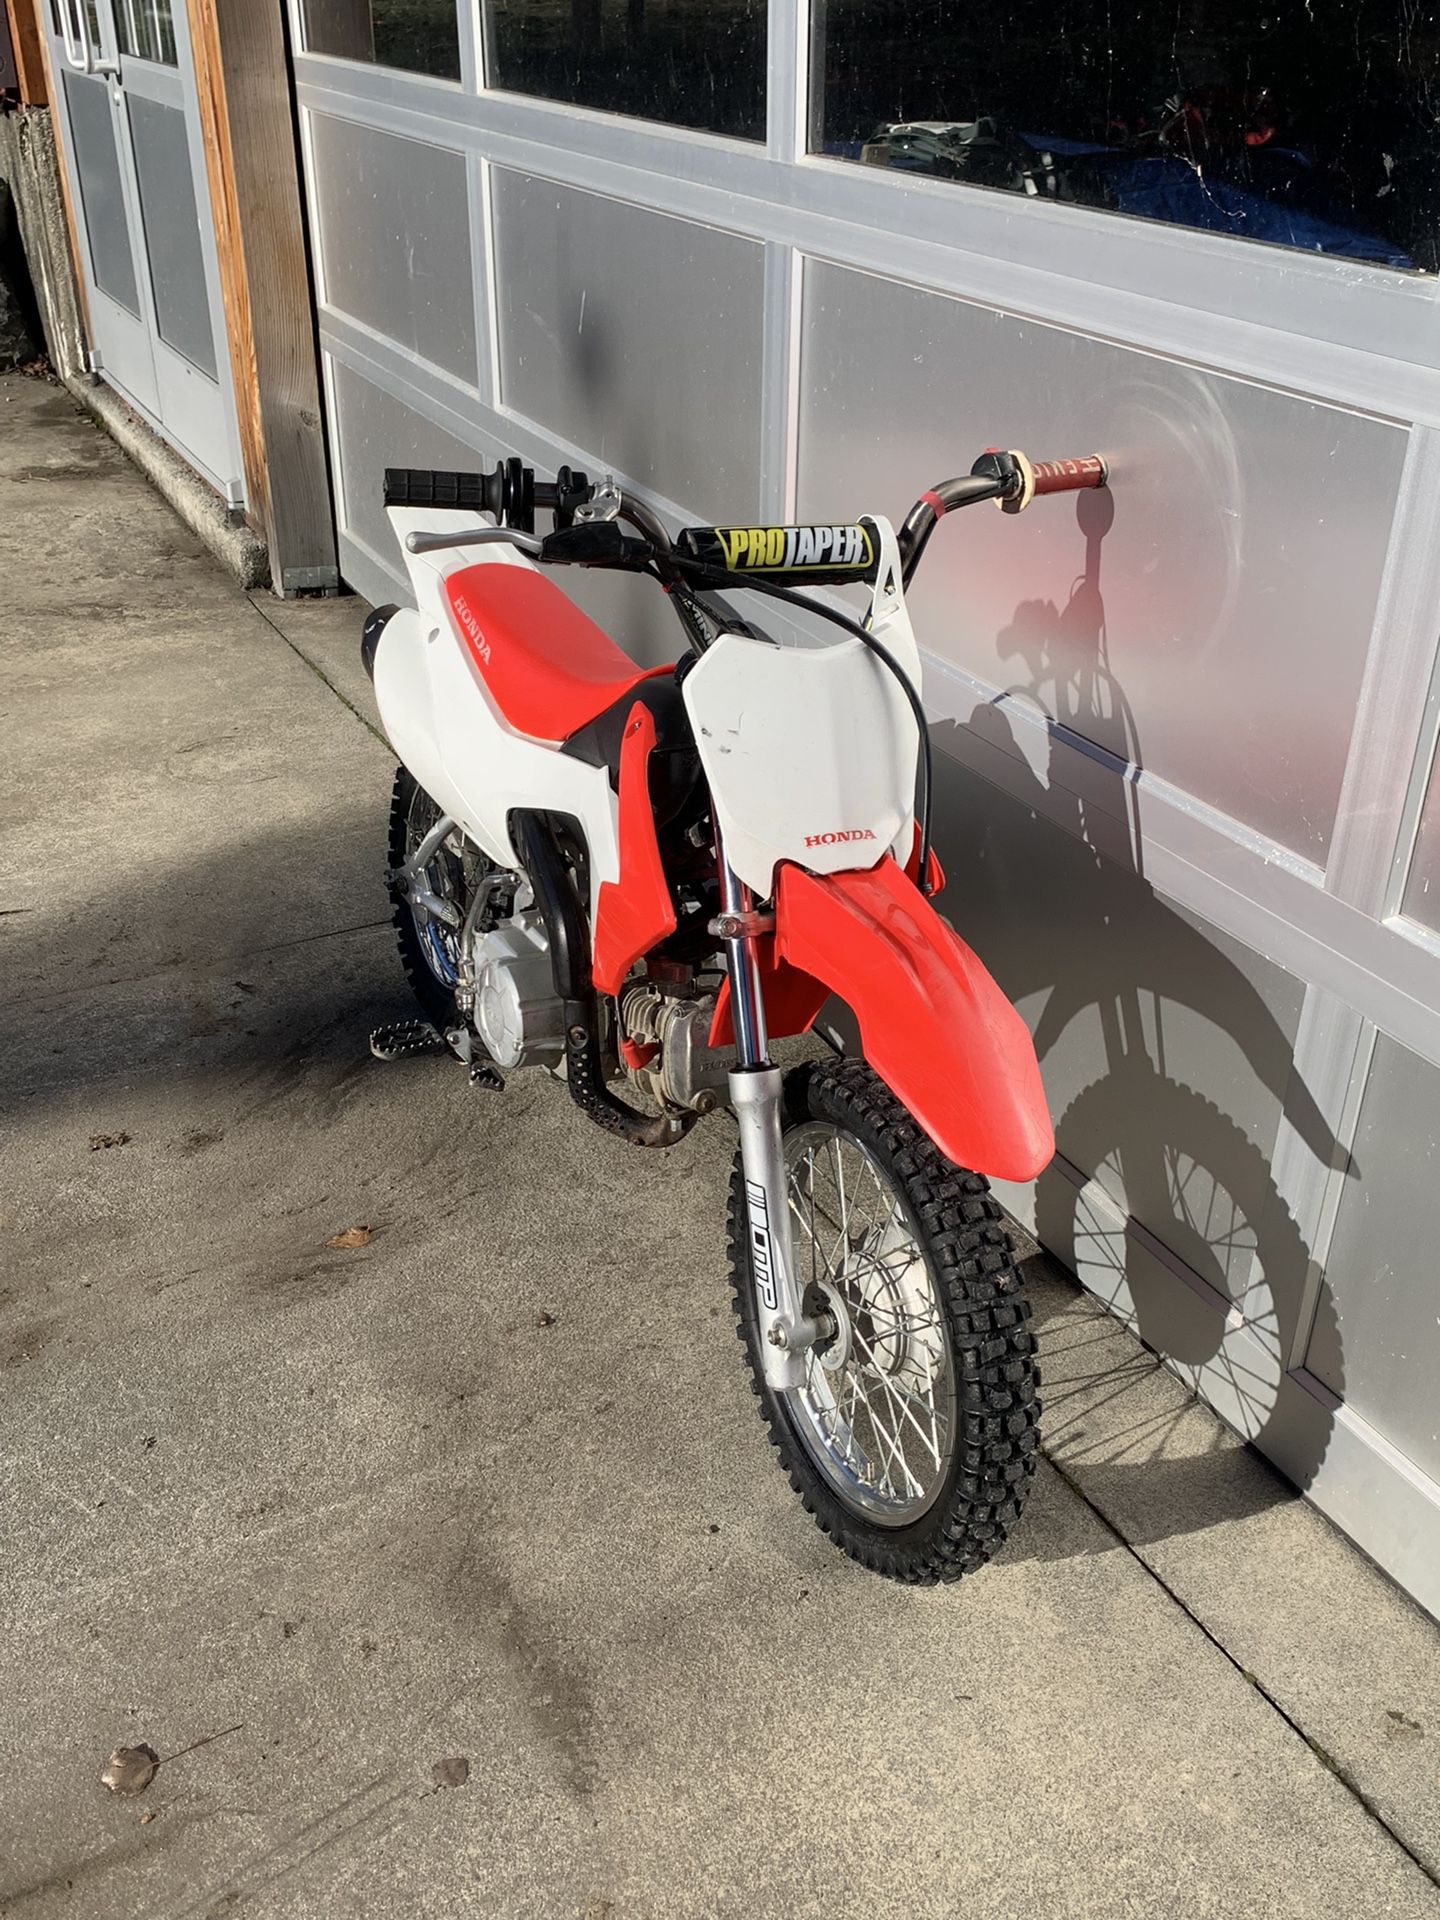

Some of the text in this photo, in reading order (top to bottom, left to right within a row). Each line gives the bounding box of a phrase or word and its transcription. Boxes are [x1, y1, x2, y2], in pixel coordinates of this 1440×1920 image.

[728, 526, 864, 569] PROTAPER
[454, 595, 491, 666] HONDA
[804, 829, 877, 848] HONDA
